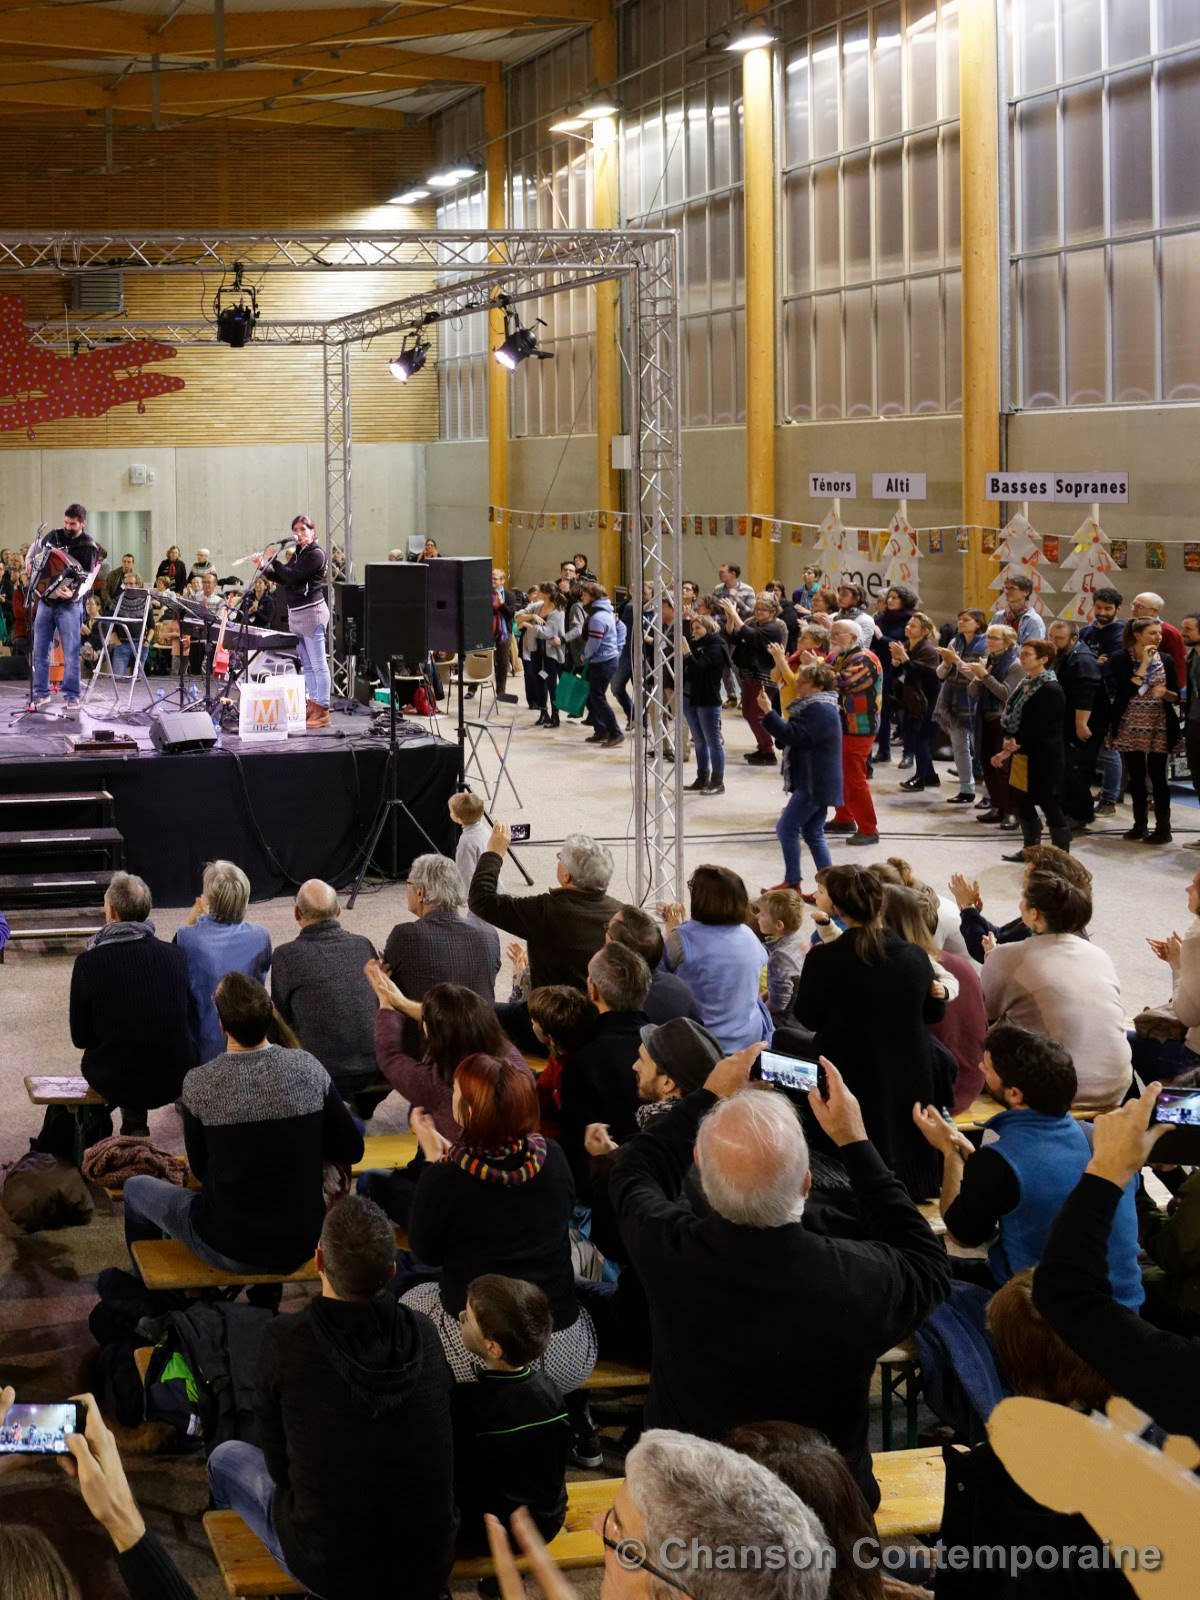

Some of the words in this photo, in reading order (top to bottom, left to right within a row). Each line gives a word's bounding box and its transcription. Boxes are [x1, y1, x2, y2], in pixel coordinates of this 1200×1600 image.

[812, 477, 851, 492] Ténors
[886, 478, 910, 493] Alti
[990, 477, 1047, 494] Basses
[1055, 478, 1126, 498] Sopranes
